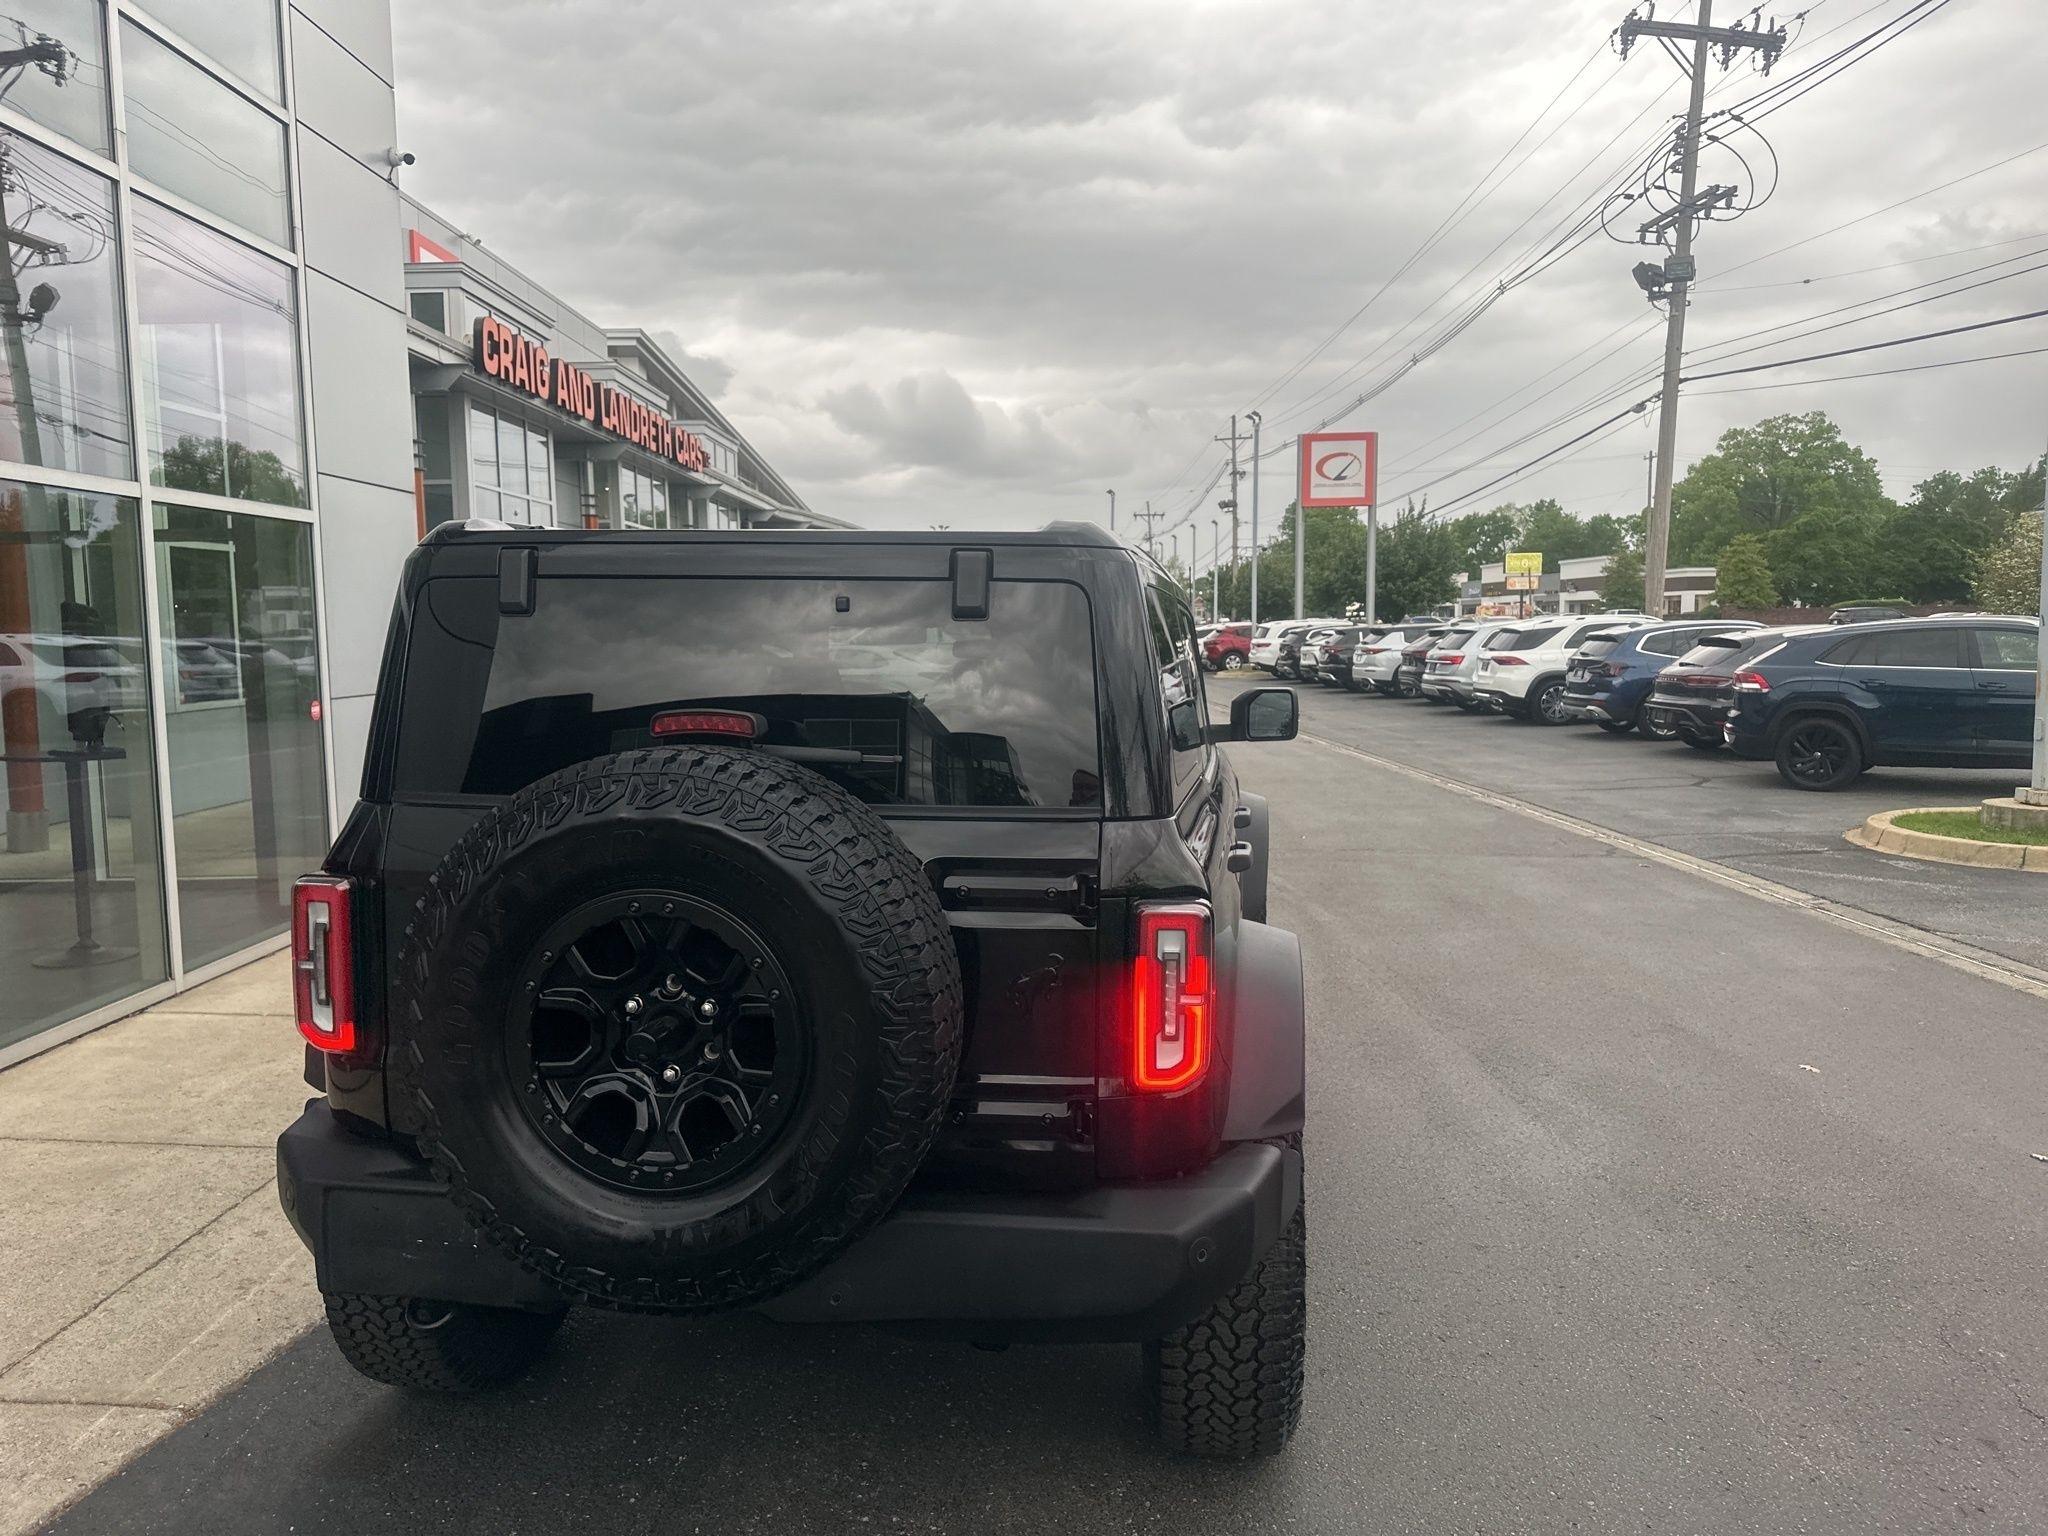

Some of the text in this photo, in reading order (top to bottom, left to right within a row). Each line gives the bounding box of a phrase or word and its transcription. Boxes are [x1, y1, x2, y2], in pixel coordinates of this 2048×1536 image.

[482, 316, 704, 473] CRAIG AND LANDRETH CARS
